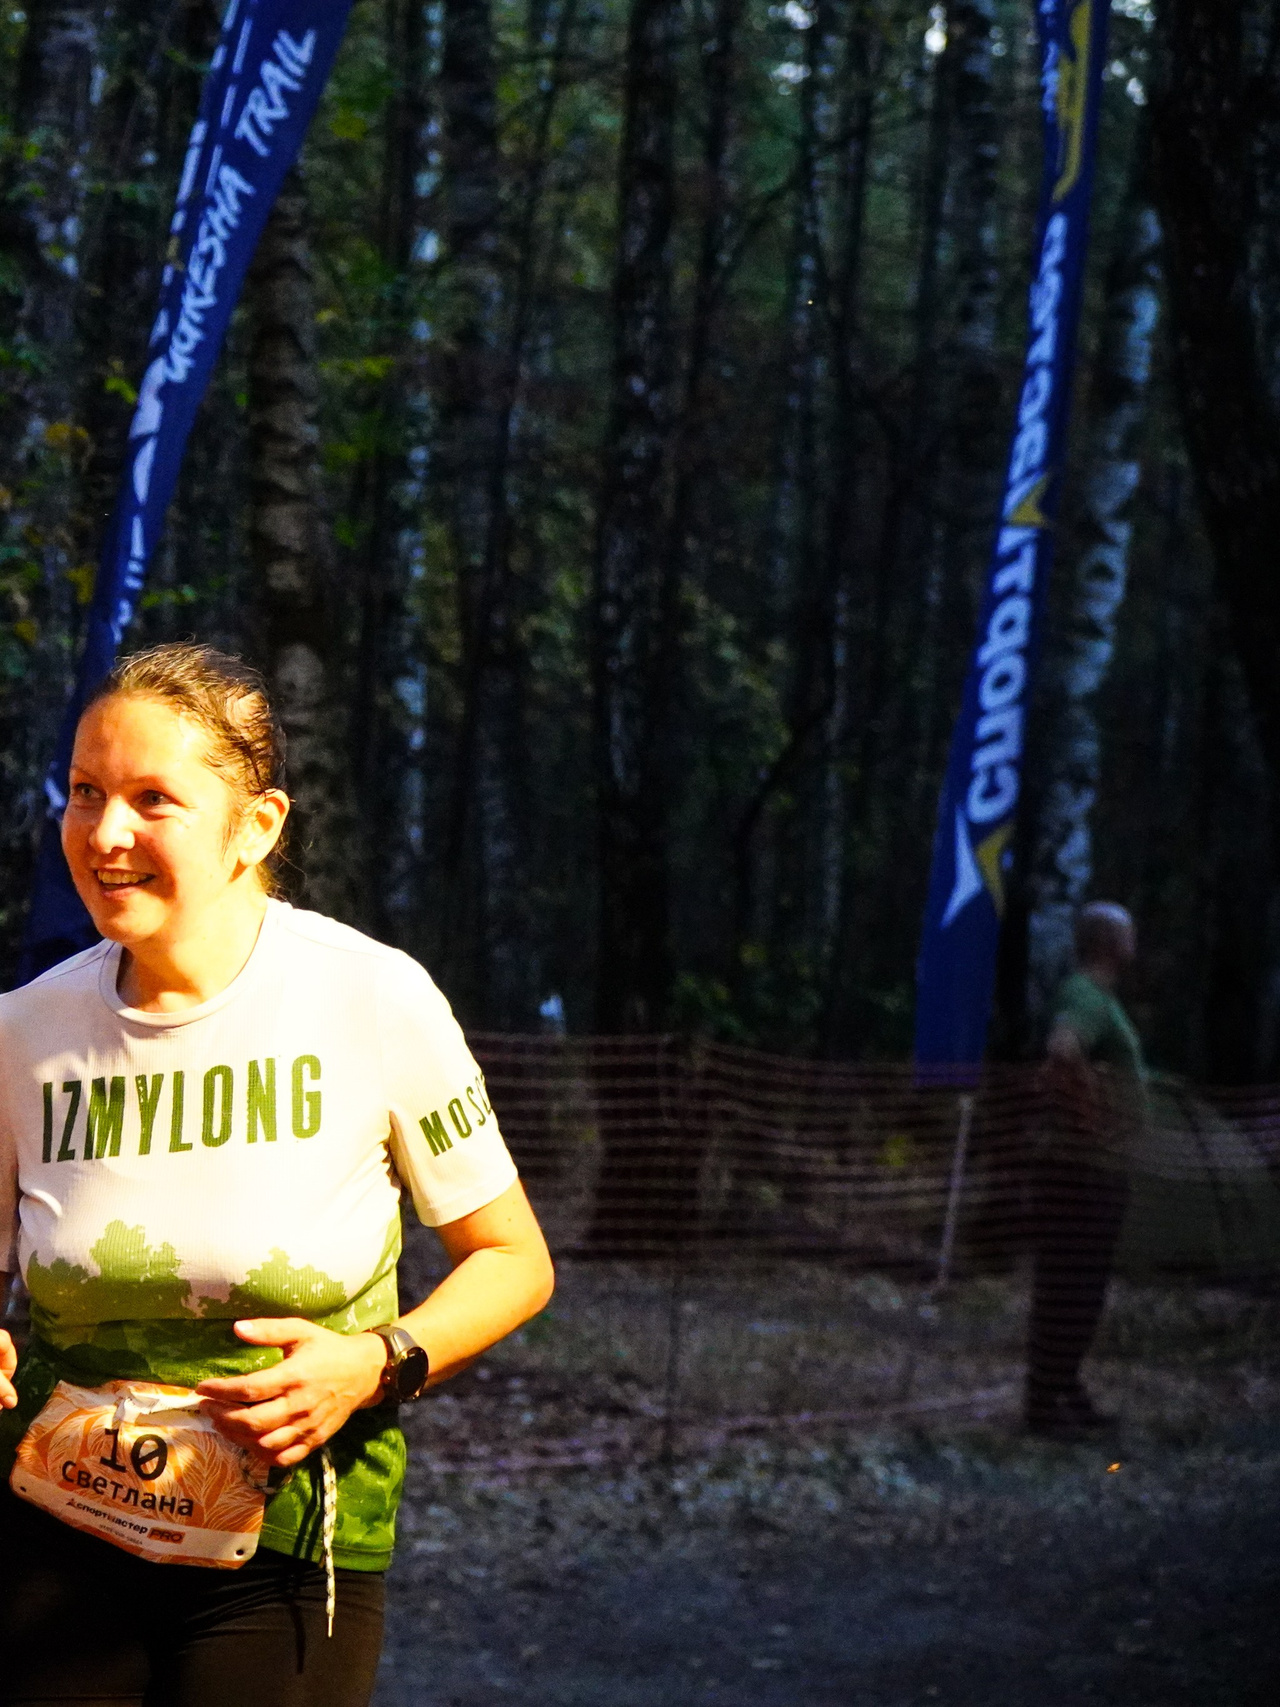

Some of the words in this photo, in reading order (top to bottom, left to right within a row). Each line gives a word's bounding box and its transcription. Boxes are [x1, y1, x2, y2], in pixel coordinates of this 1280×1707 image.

[233, 28, 317, 158] TRAIL
[40, 1054, 322, 1164] IZMYLONG
[100, 1427, 168, 1481] 10
[61, 1460, 195, 1518] Светлана
[149, 1527, 185, 1543] PRO
